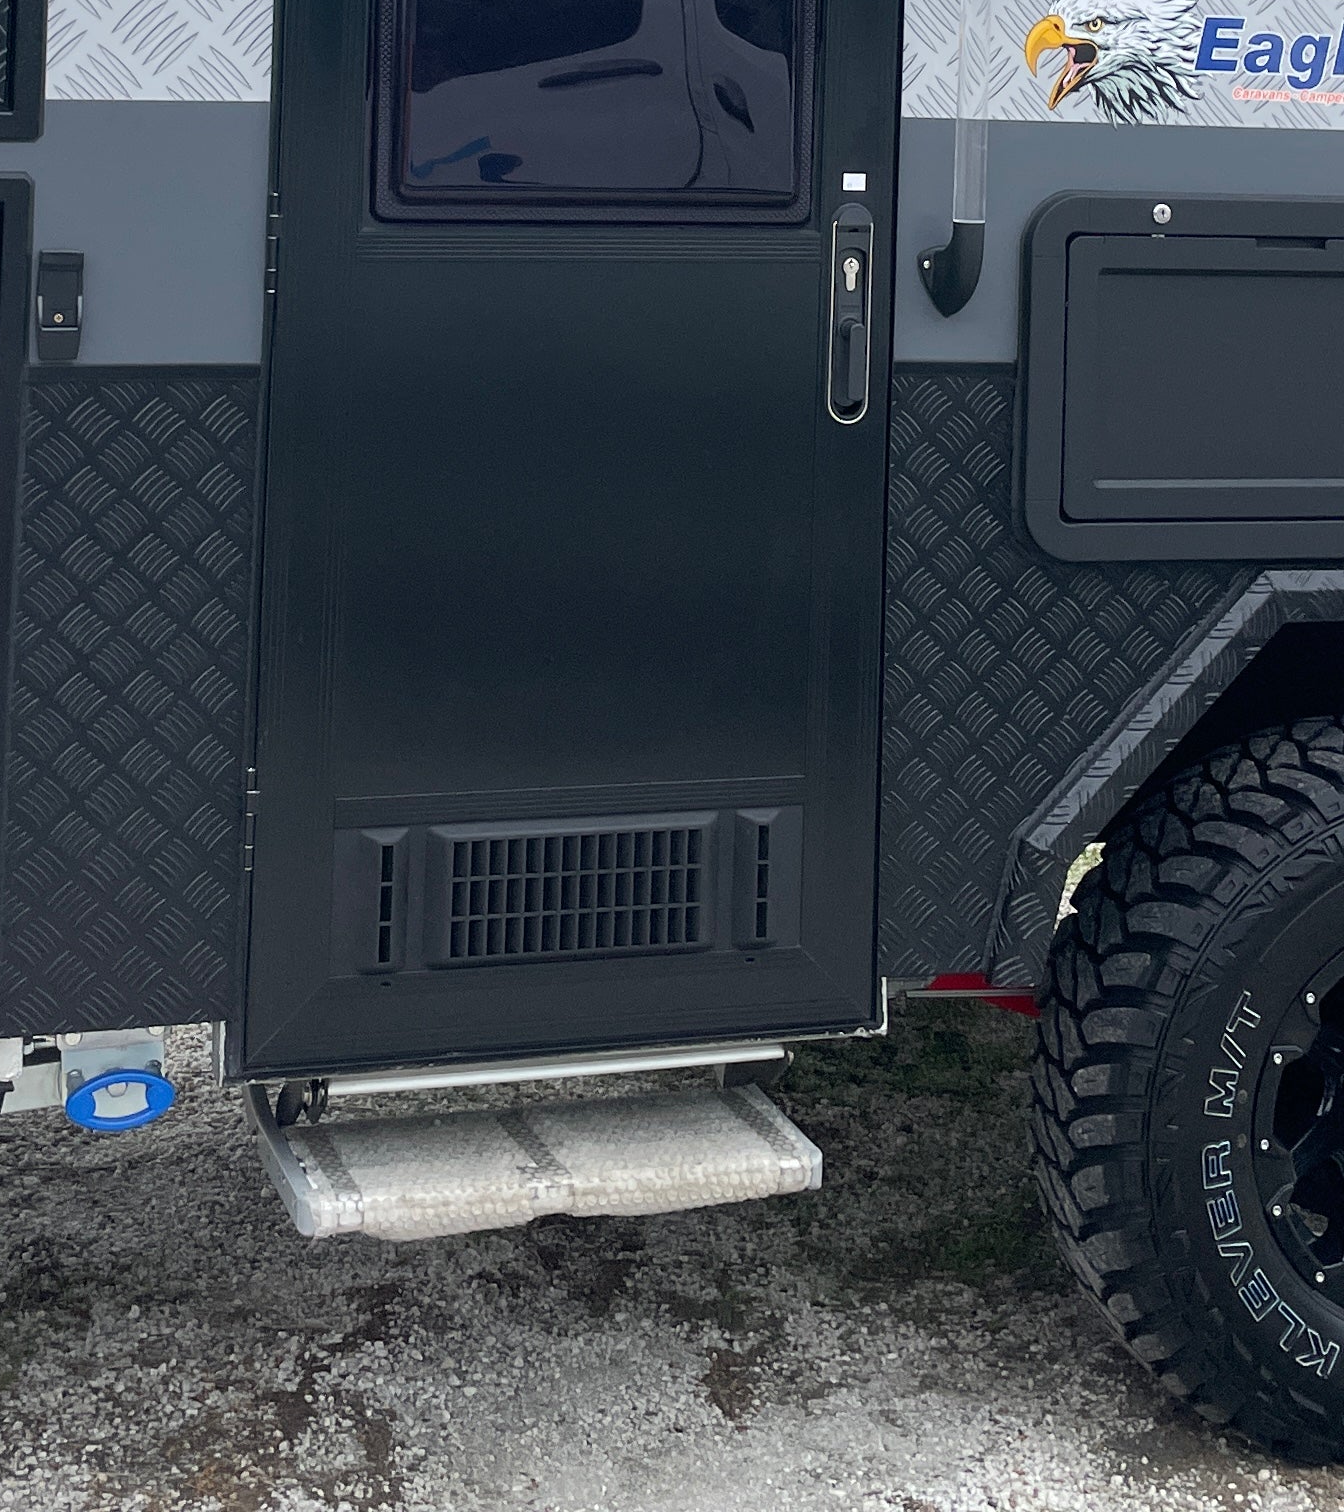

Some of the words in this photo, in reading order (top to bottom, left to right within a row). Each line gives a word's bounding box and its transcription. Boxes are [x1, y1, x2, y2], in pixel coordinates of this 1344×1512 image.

[1232, 85, 1291, 102] Caravans
[1203, 990, 1262, 1118] M/T
[1202, 1140, 1340, 1378] KLEVER
